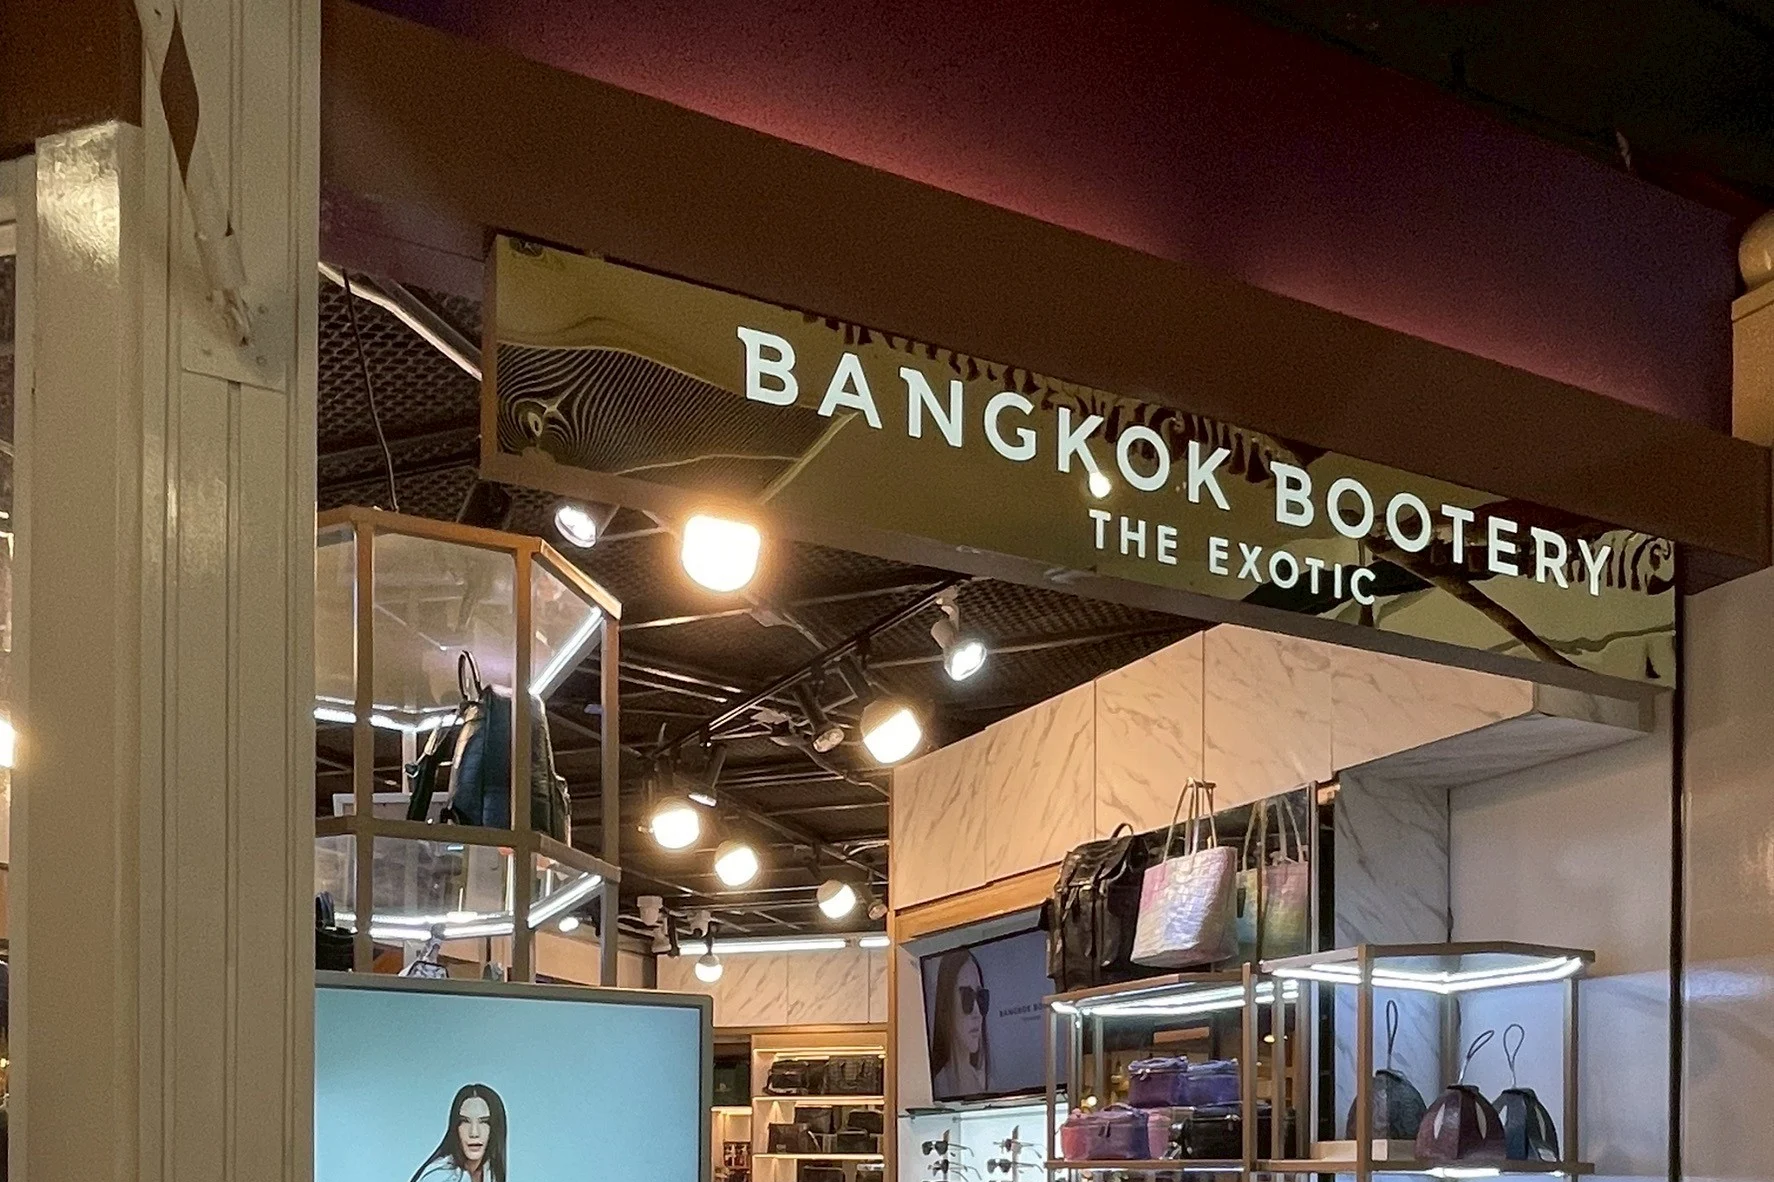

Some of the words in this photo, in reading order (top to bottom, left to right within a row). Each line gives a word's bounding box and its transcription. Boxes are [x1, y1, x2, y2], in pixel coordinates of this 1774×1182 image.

[736, 325, 1232, 511] BANGKOK
[1269, 460, 1612, 598] BOOTERY
[1088, 508, 1178, 566] THE
[1208, 535, 1377, 606] EXOTIC
